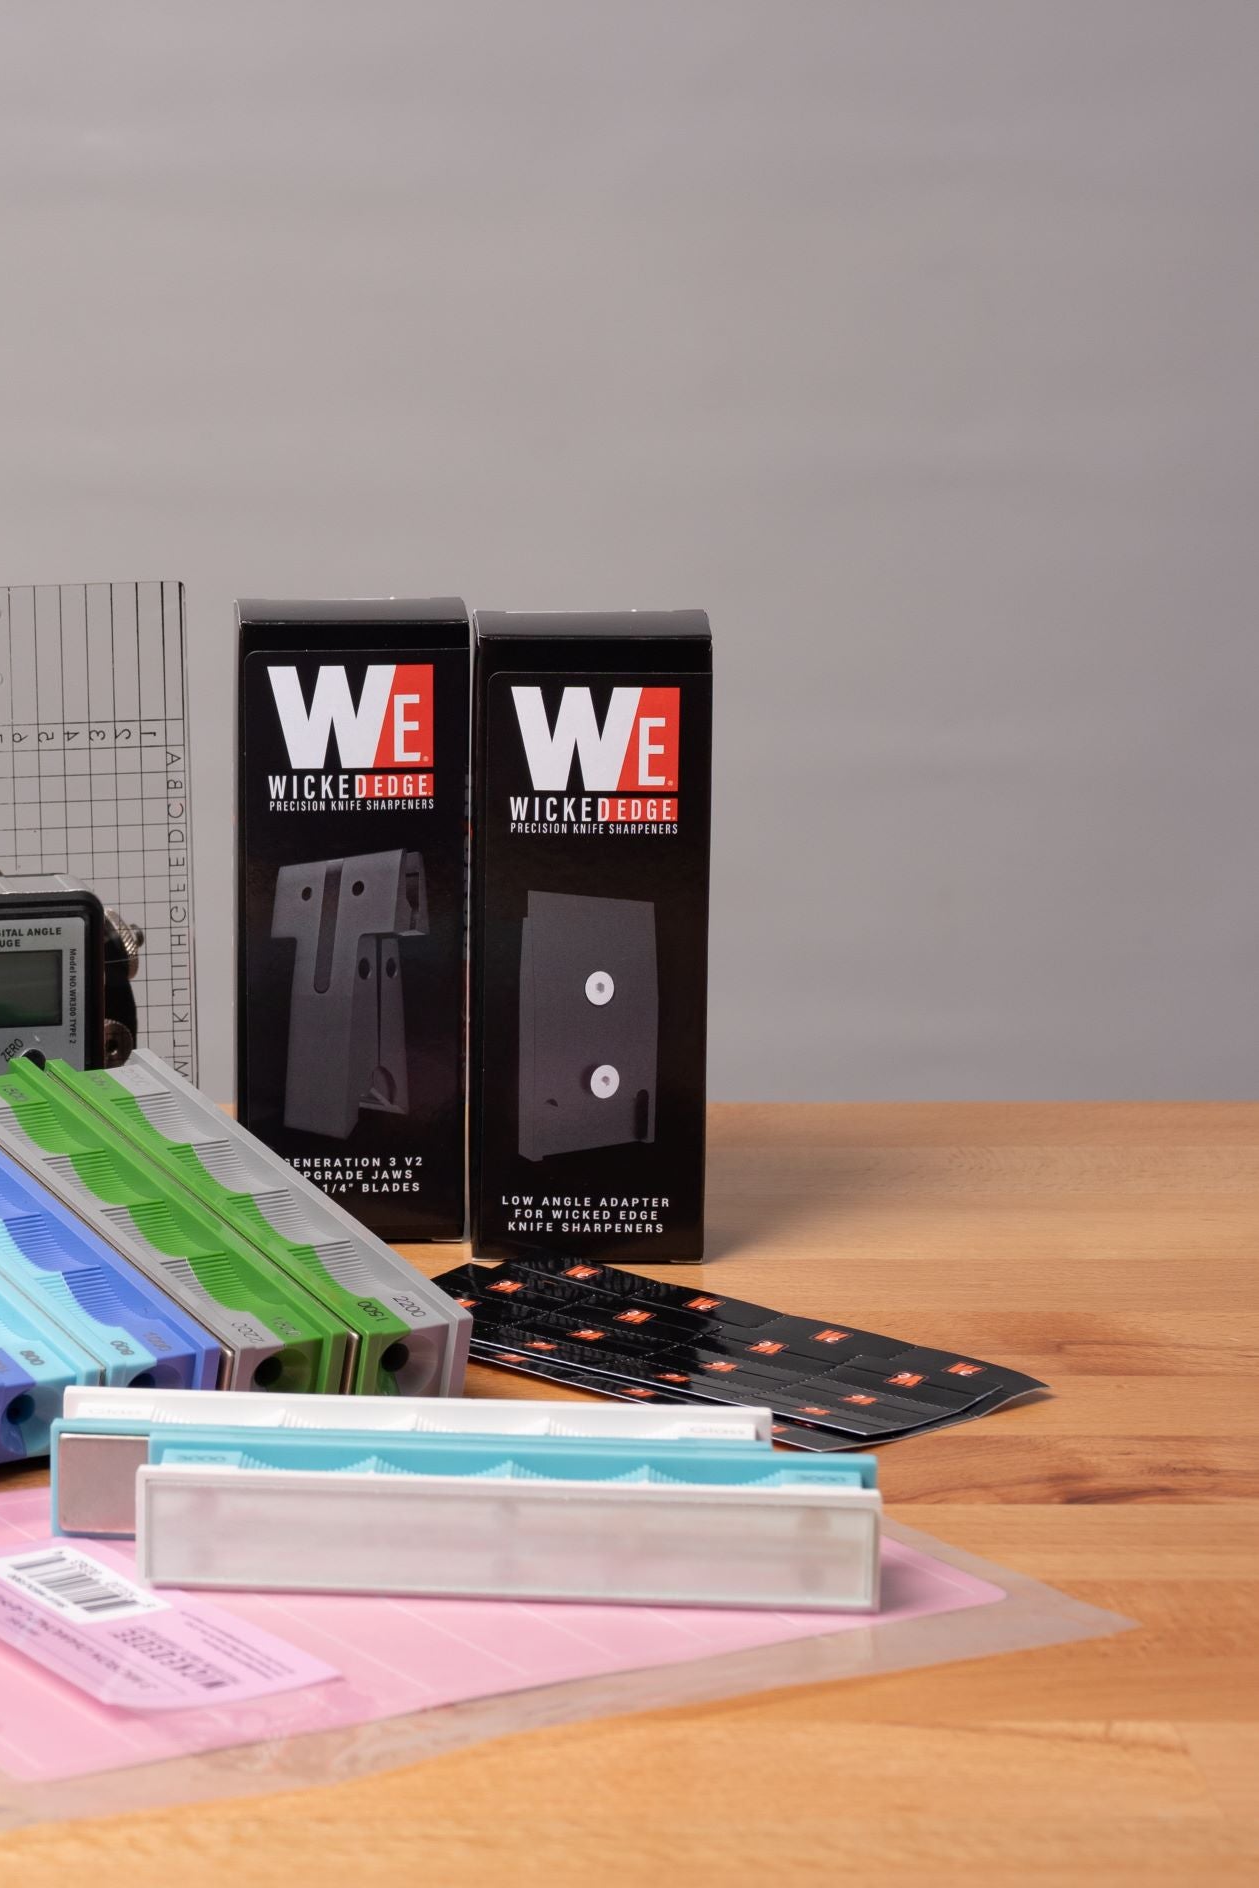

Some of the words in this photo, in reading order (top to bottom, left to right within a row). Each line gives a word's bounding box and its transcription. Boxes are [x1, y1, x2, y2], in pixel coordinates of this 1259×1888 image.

[267, 664, 422, 769] WE
[510, 686, 666, 791] WE
[269, 801, 325, 812] PRECISION
[331, 801, 361, 811] KNIFE
[366, 799, 434, 810] SHARPENERS
[510, 823, 567, 834] PRECISION
[573, 823, 604, 834] KNIFE
[609, 823, 678, 835] SHARPENERS
[27, 927, 62, 936] ANGLE
[0, 1038, 24, 1062] ZERO
[389, 1157, 397, 1167] 3
[405, 1157, 423, 1167] V2
[300, 1170, 364, 1180] PGRADE
[371, 1170, 413, 1179] JAWS
[362, 1182, 420, 1193] BLADES
[502, 1196, 533, 1205] LOW
[542, 1197, 591, 1207] ANGLE
[600, 1198, 670, 1208] ADAPTER
[515, 1209, 543, 1219] FOR
[552, 1210, 611, 1220] WICKED
[619, 1211, 658, 1221] EDGE
[508, 1222, 553, 1232] KNIFE
[562, 1223, 664, 1233] SHARPENERS
[357, 1300, 391, 1322] 1500
[392, 1295, 428, 1318] 2200
